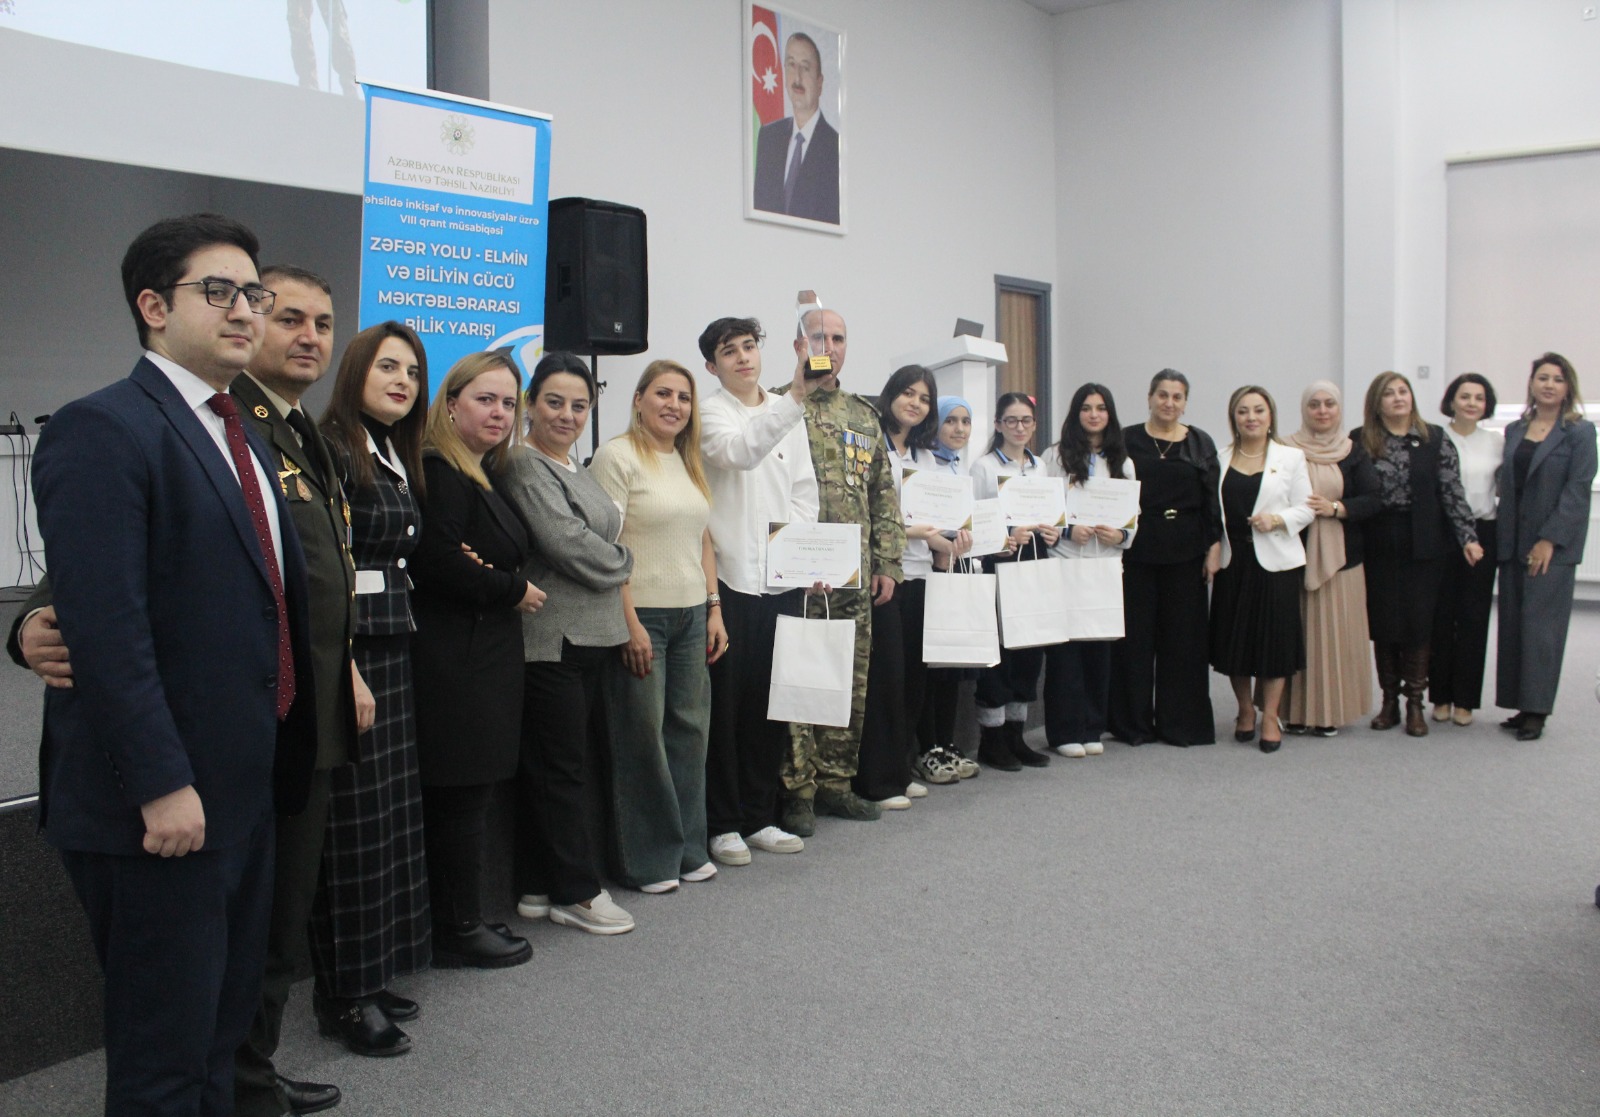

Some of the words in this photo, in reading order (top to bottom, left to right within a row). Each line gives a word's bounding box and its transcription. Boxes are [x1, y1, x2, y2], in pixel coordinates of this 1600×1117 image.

[388, 156, 455, 175] AZƏRBAYCAN
[394, 170, 417, 183] ELM
[419, 175, 431, 184] VƏ
[434, 176, 467, 190] TƏHSİL
[470, 181, 515, 197] NAZİRLİYİ
[364, 194, 403, 208] əhsildə
[405, 198, 439, 214] inkişaf
[442, 206, 453, 215] və
[455, 205, 517, 223] innovasiyalar
[519, 215, 540, 226] üzrə
[399, 214, 417, 225] VIII
[419, 218, 446, 229] qrant
[449, 221, 503, 236] müsabiqəsi
[370, 237, 426, 256] ZƏFƏR
[430, 243, 471, 260] YOLU
[484, 249, 528, 266] ELMİN
[386, 265, 410, 280] VƏ
[414, 265, 468, 285] BİLİYİN
[473, 272, 515, 289] GÜCÜ
[378, 290, 520, 314] MƏKTƏBLƏRARASI
[405, 315, 445, 334] BİLİK
[448, 320, 496, 340] YARIŞI
